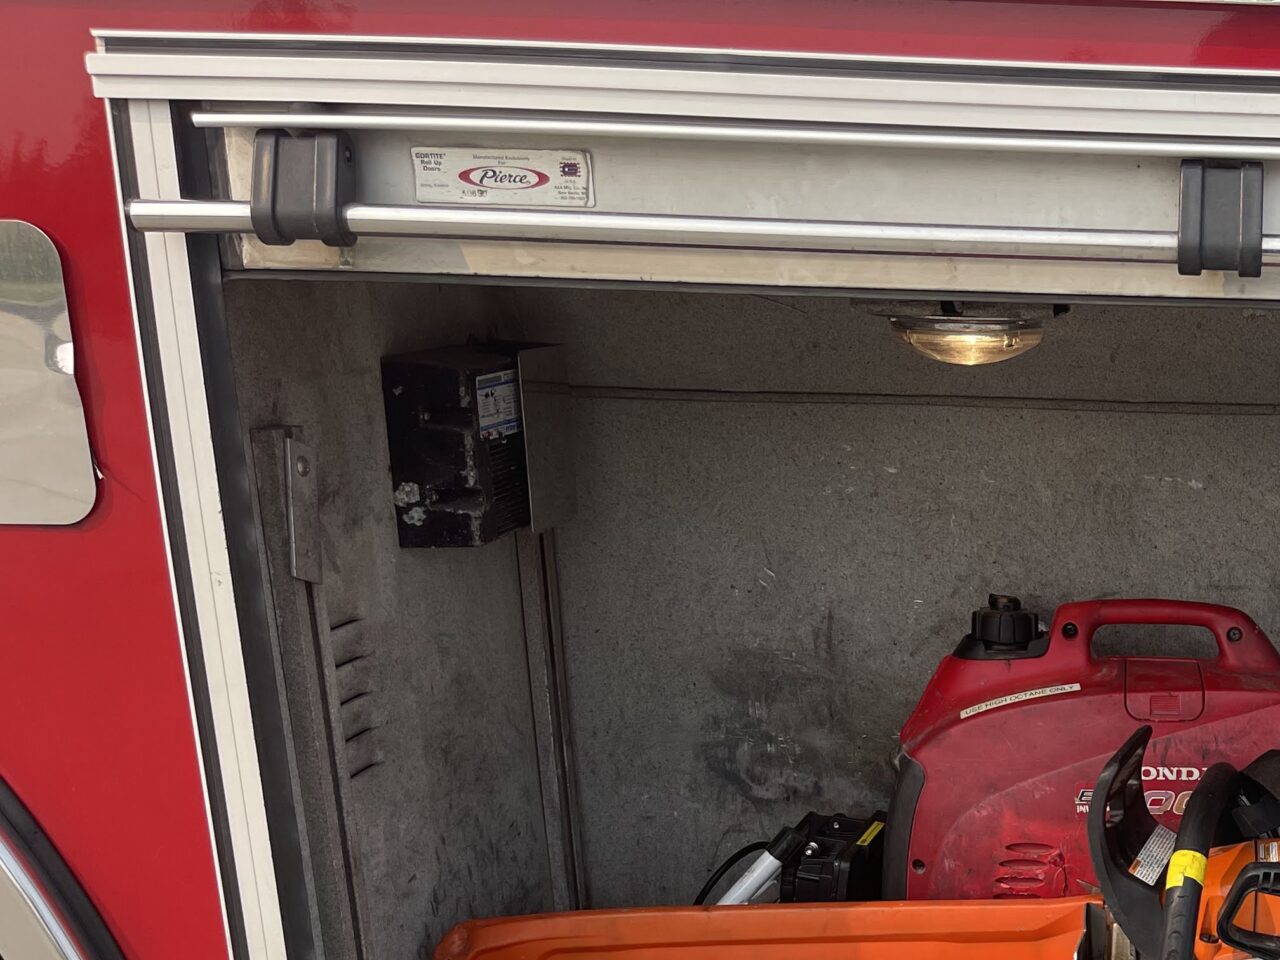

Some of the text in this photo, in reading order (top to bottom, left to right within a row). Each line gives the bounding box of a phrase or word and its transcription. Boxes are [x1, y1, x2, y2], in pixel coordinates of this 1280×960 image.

[480, 168, 527, 185] Pierce
[965, 685, 1074, 715] USE HIGH OCTANE ONLY
[1141, 766, 1207, 781] OND
